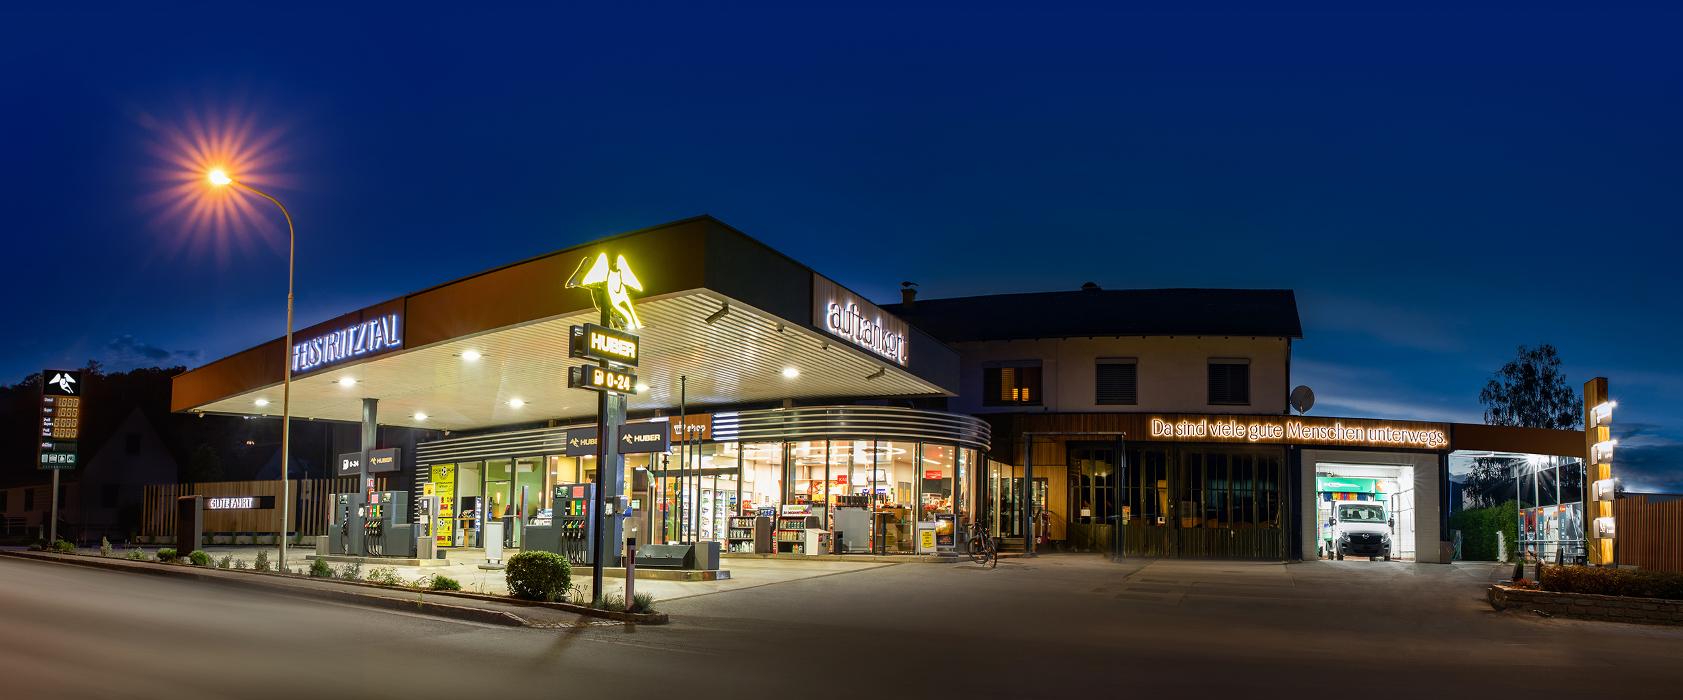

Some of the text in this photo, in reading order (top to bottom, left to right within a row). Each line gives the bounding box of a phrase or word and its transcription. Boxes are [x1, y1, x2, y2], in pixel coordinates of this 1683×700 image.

[591, 332, 636, 358] HUBER
[606, 372, 631, 391] 0-24
[634, 433, 661, 442] HUBER
[1151, 419, 1447, 447] Da sind viele gute Menschen unterwegs.
[580, 438, 598, 446] HUBE
[209, 498, 230, 509] GUTE
